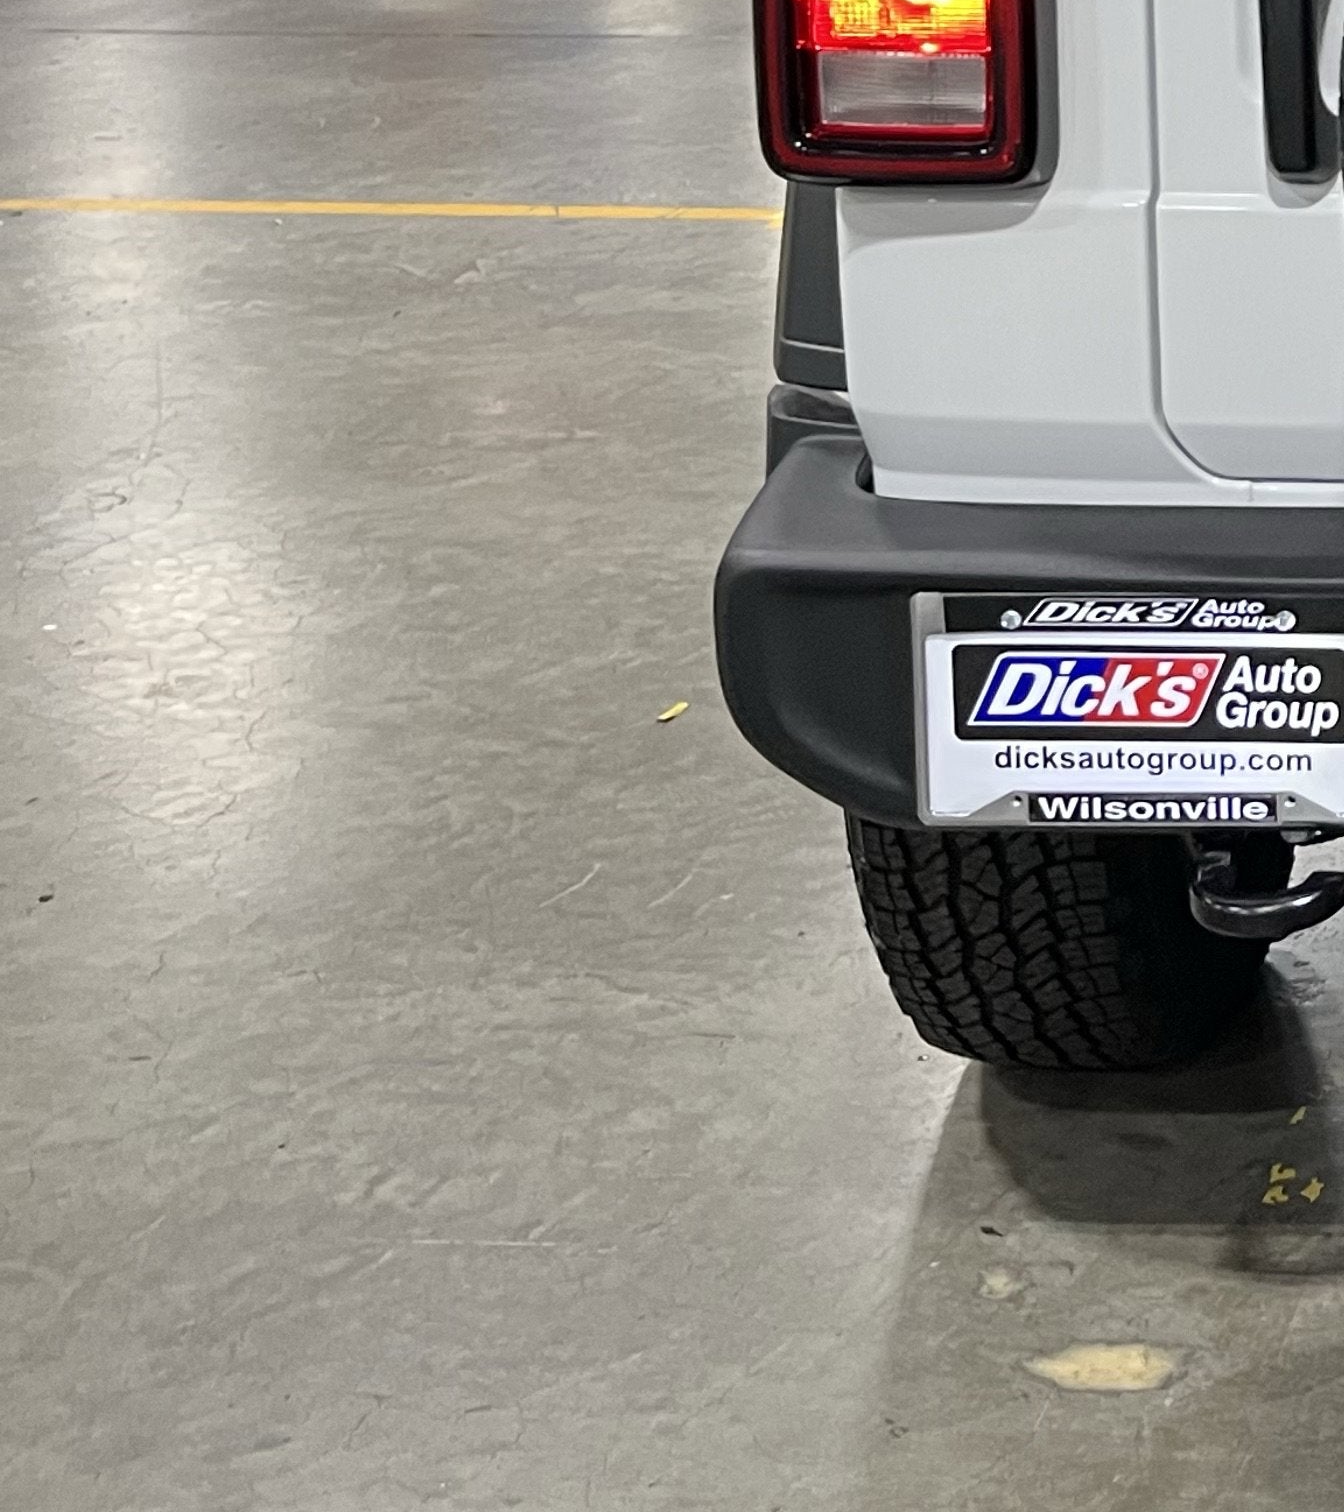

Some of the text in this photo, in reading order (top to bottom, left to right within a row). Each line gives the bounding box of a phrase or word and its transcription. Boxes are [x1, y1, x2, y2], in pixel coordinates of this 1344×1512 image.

[1034, 598, 1265, 624] Dick's Auto
[1191, 612, 1279, 632] Group
[987, 655, 1322, 718] Dick's Auto
[1215, 695, 1340, 736] Group
[994, 745, 1313, 776] dicksautogroup.com
[1037, 795, 1269, 821] Wilsonville
